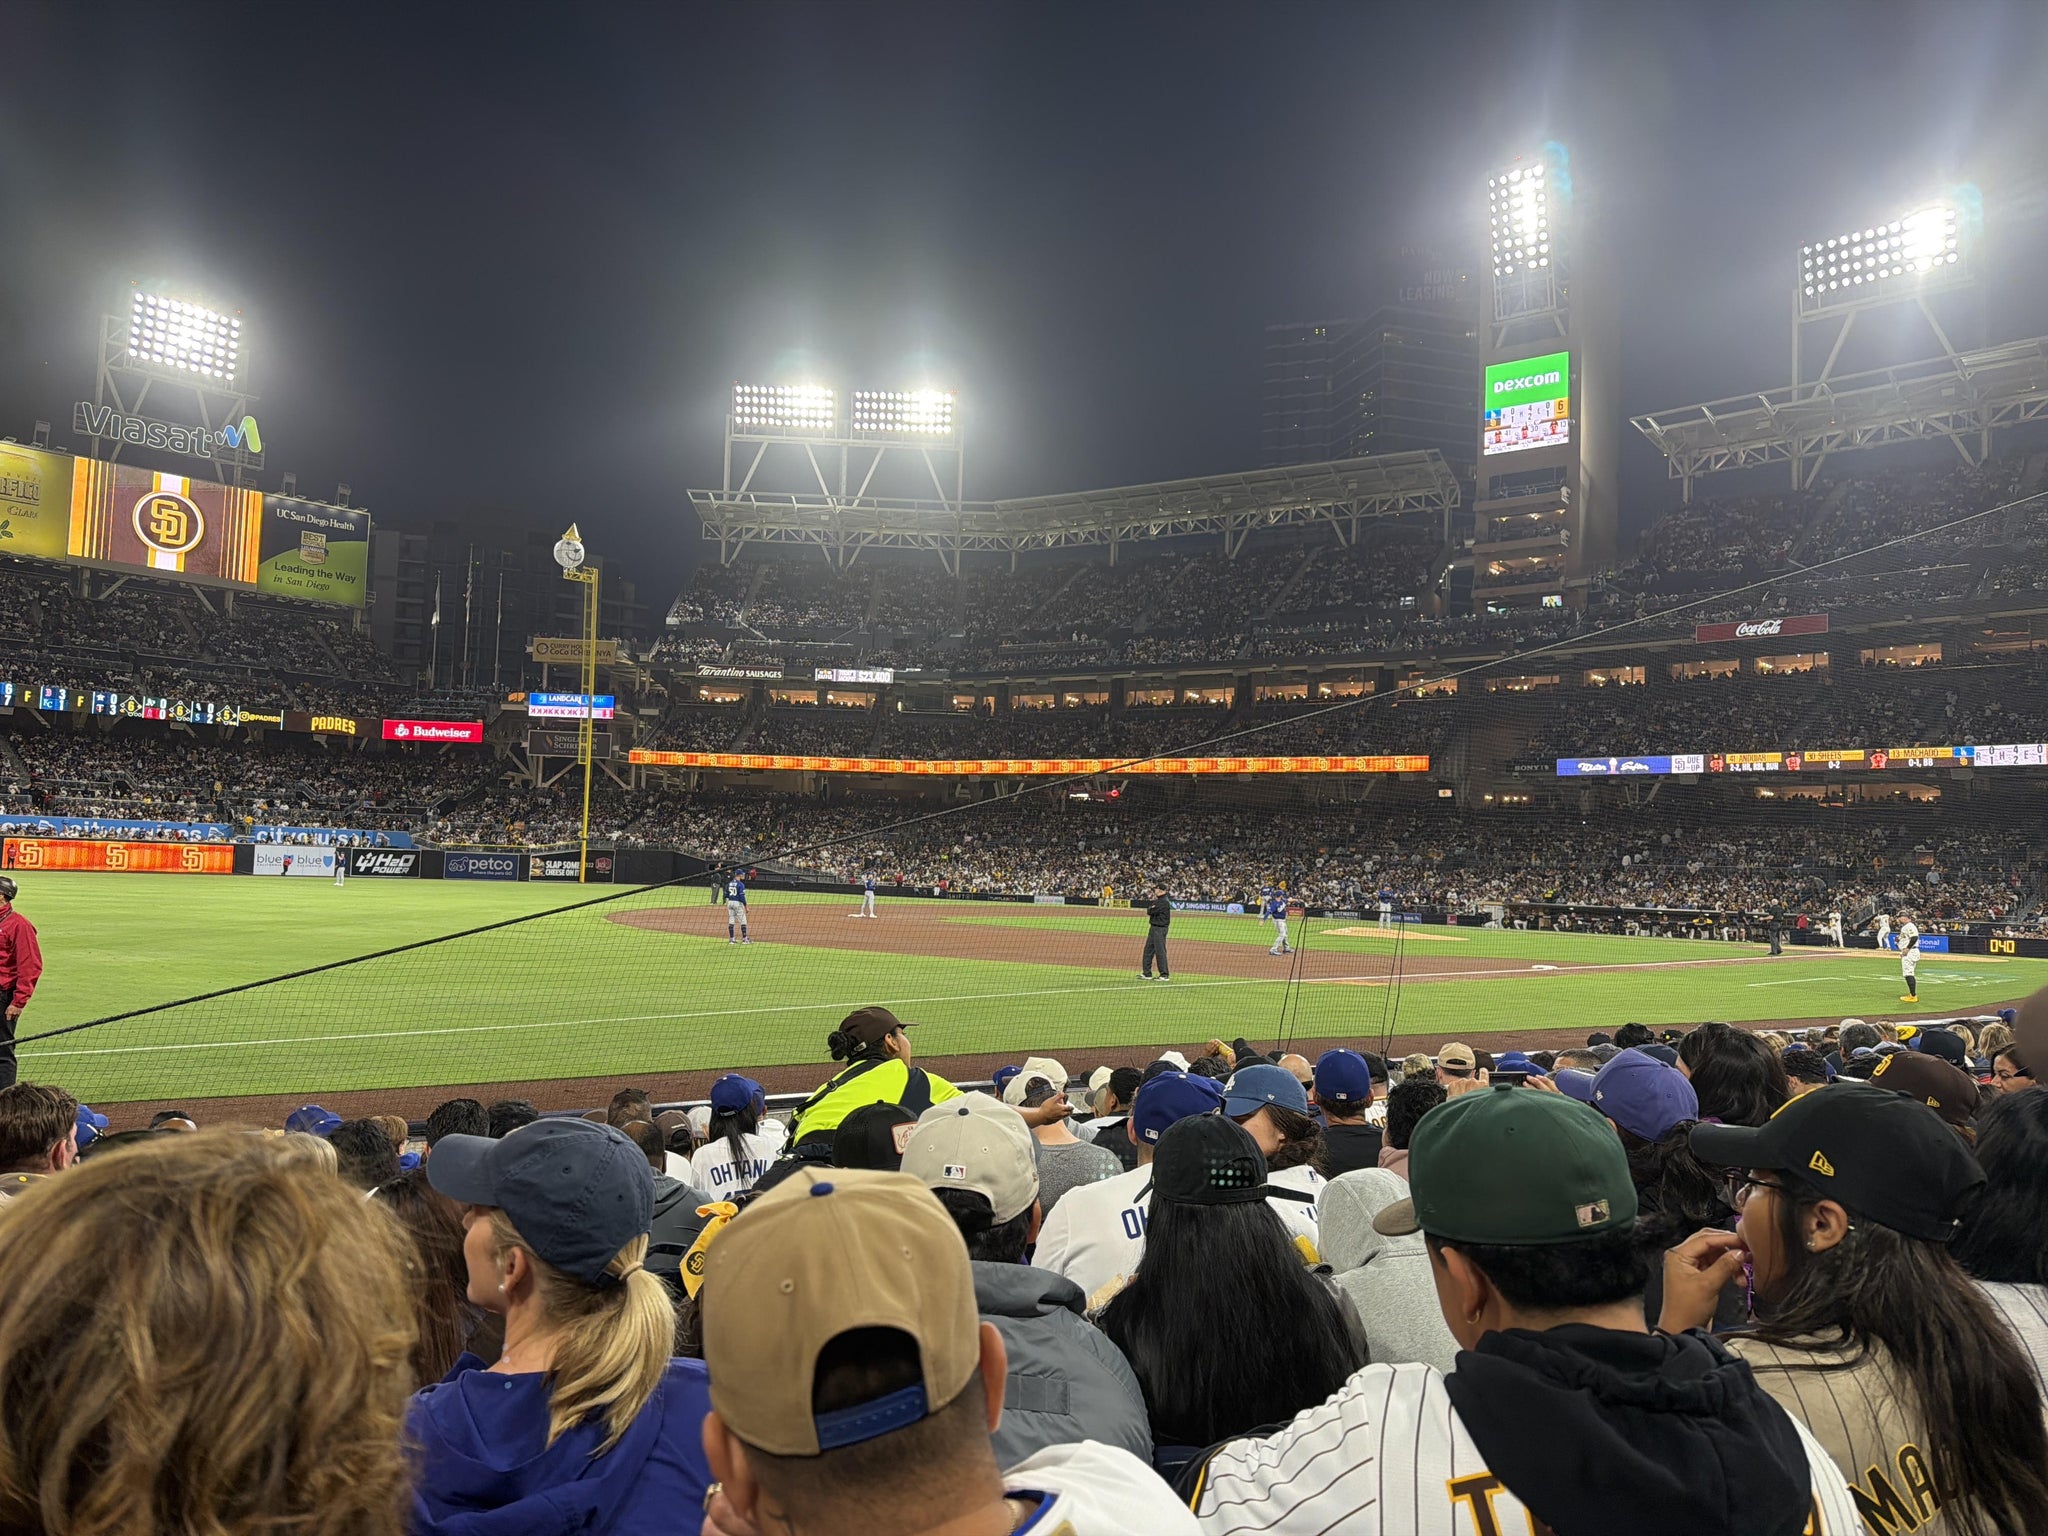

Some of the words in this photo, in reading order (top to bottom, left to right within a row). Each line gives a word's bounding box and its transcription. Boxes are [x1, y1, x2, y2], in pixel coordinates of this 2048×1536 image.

[1493, 370, 1560, 393] Dexcom
[1558, 400, 1564, 410] 6
[82, 402, 211, 458] Viasat
[276, 508, 290, 520] UC
[290, 510, 306, 522] San
[306, 514, 329, 528] Diego
[330, 518, 355, 531] Health
[274, 562, 315, 578] Leading
[317, 568, 333, 579] the
[336, 572, 356, 584] Way
[274, 574, 282, 584] in
[286, 576, 302, 586] San
[306, 580, 330, 591] Diego
[1736, 620, 1784, 637] Coca-Cola
[698, 665, 744, 678] Tarantino
[746, 670, 782, 679] SAUSAGES
[4, 684, 12, 694] 6
[24, 690, 32, 702] F
[58, 688, 66, 700] 3
[77, 695, 84, 708] F
[110, 694, 118, 705] 0
[127, 700, 134, 712] 6
[160, 698, 167, 710] 0
[176, 706, 184, 716] 6
[208, 703, 214, 714] 0
[223, 710, 230, 721] 5
[4, 694, 12, 706] 7
[109, 704, 117, 716] 3
[159, 710, 166, 720] 0
[206, 714, 214, 724] 2
[248, 712, 281, 723] @PADRES
[310, 716, 356, 735] PADRES
[413, 726, 472, 738] Budweiser
[1808, 752, 1816, 760] 30
[1818, 751, 1842, 760] SHEETS
[1892, 750, 1900, 758] 13
[1904, 749, 1938, 758] MACHADO
[1989, 746, 1994, 755] 0
[2014, 746, 2018, 754] 4
[2037, 744, 2043, 754] 0
[2000, 751, 2005, 760] H
[2024, 750, 2029, 760] E
[1687, 756, 1700, 764] DUE
[1828, 761, 1840, 769] 0-2
[2014, 756, 2018, 764] 2
[106, 844, 128, 870] SD
[182, 846, 204, 872] SD
[256, 854, 282, 864] blue
[298, 854, 322, 864] blue
[375, 854, 416, 866] H2O
[372, 866, 410, 874] POWER
[468, 857, 513, 872] petco
[546, 860, 562, 869] SLAP
[563, 860, 580, 869] SOME
[728, 886, 737, 896] 50
[1990, 939, 2015, 953] 040
